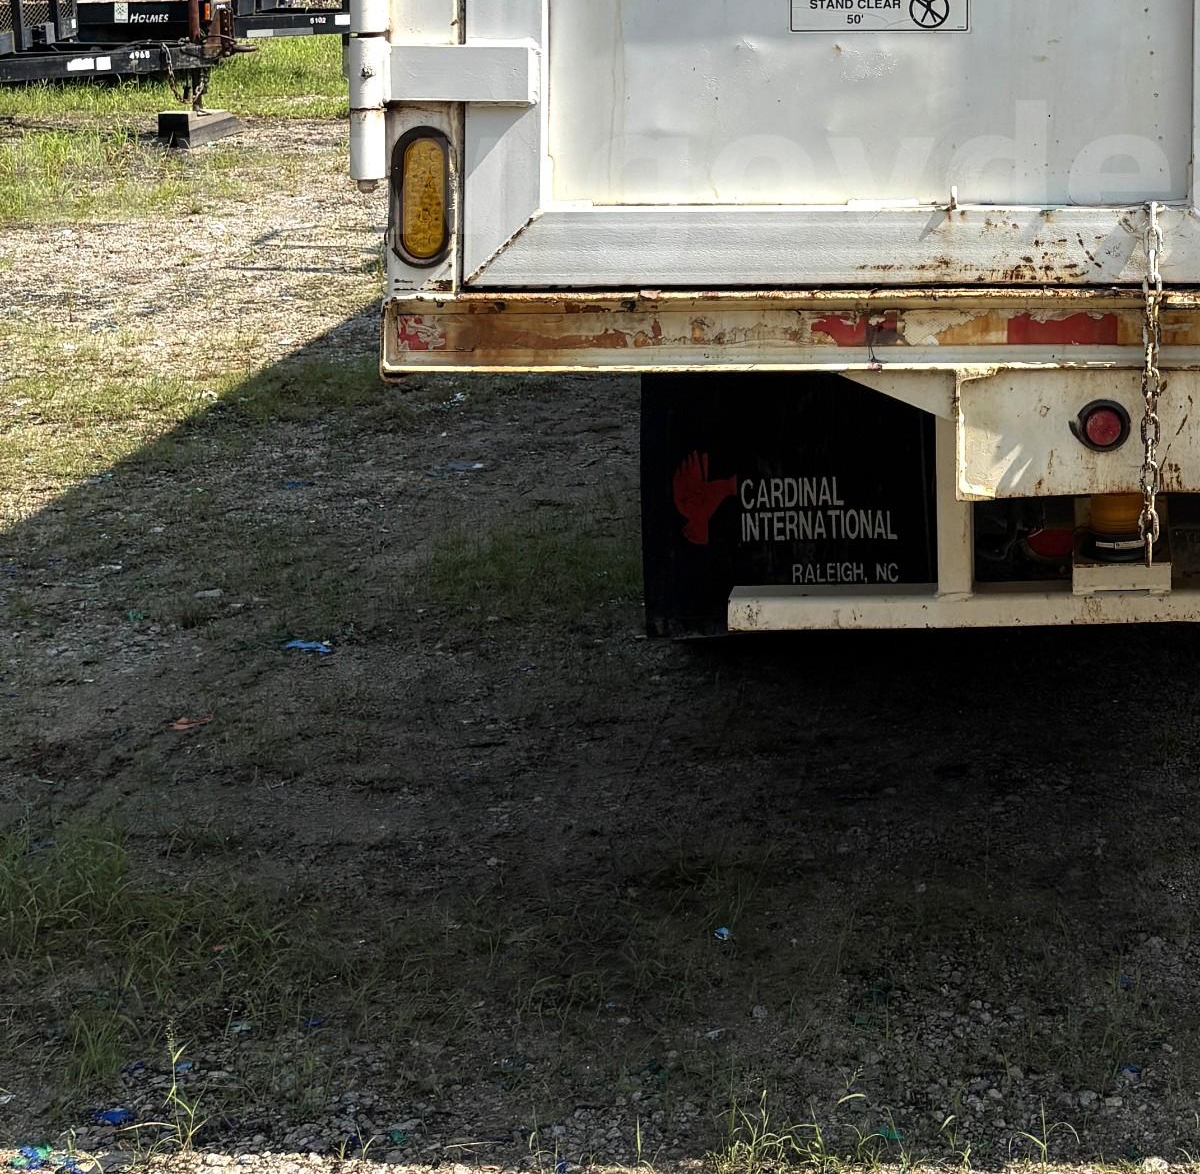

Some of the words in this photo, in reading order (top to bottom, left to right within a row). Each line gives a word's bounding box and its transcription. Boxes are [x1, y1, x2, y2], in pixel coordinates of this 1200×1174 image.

[846, 14, 864, 25] 50'
[741, 476, 845, 509] CARDINAL
[741, 509, 898, 542] INTERNATIONAL
[792, 562, 868, 584] RALEIGH,
[876, 562, 899, 583] NC
